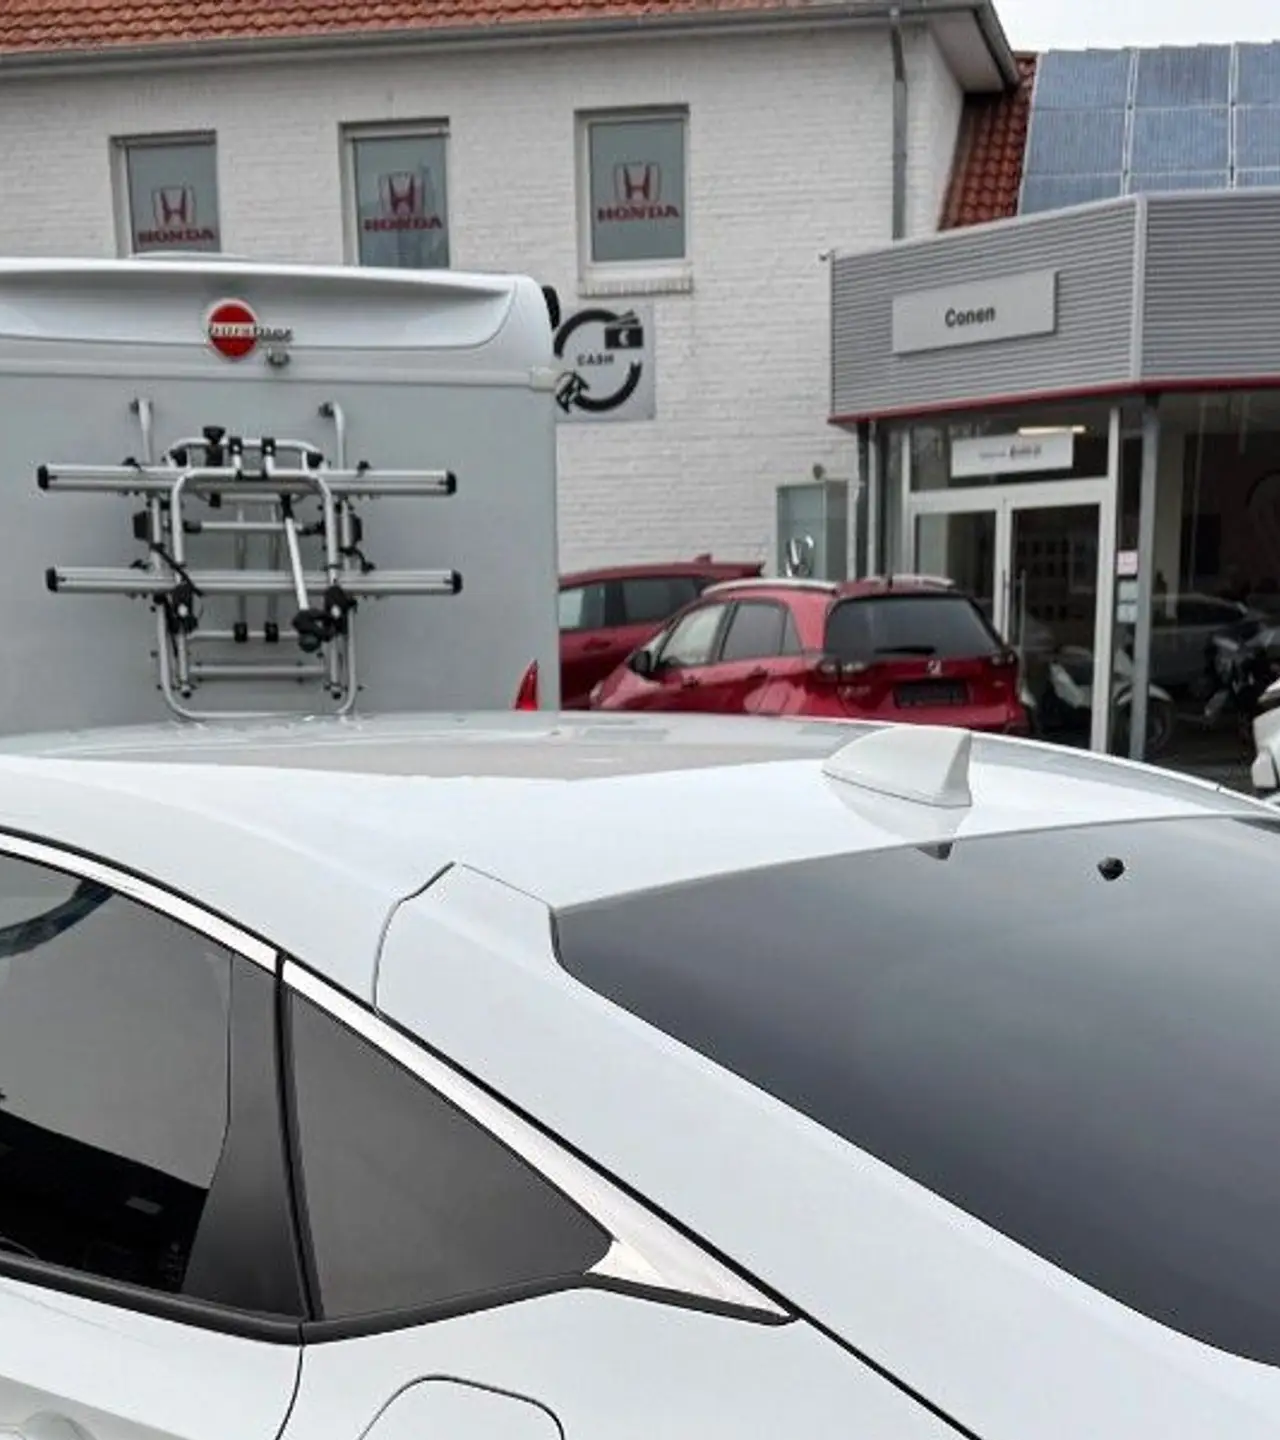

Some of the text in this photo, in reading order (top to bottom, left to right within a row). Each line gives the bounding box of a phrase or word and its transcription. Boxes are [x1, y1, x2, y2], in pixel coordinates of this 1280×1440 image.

[597, 204, 680, 222] HONDA
[363, 214, 443, 231] HONDA
[137, 227, 215, 243] HONDA
[945, 306, 997, 328] Conen
[577, 352, 615, 366] CASH
